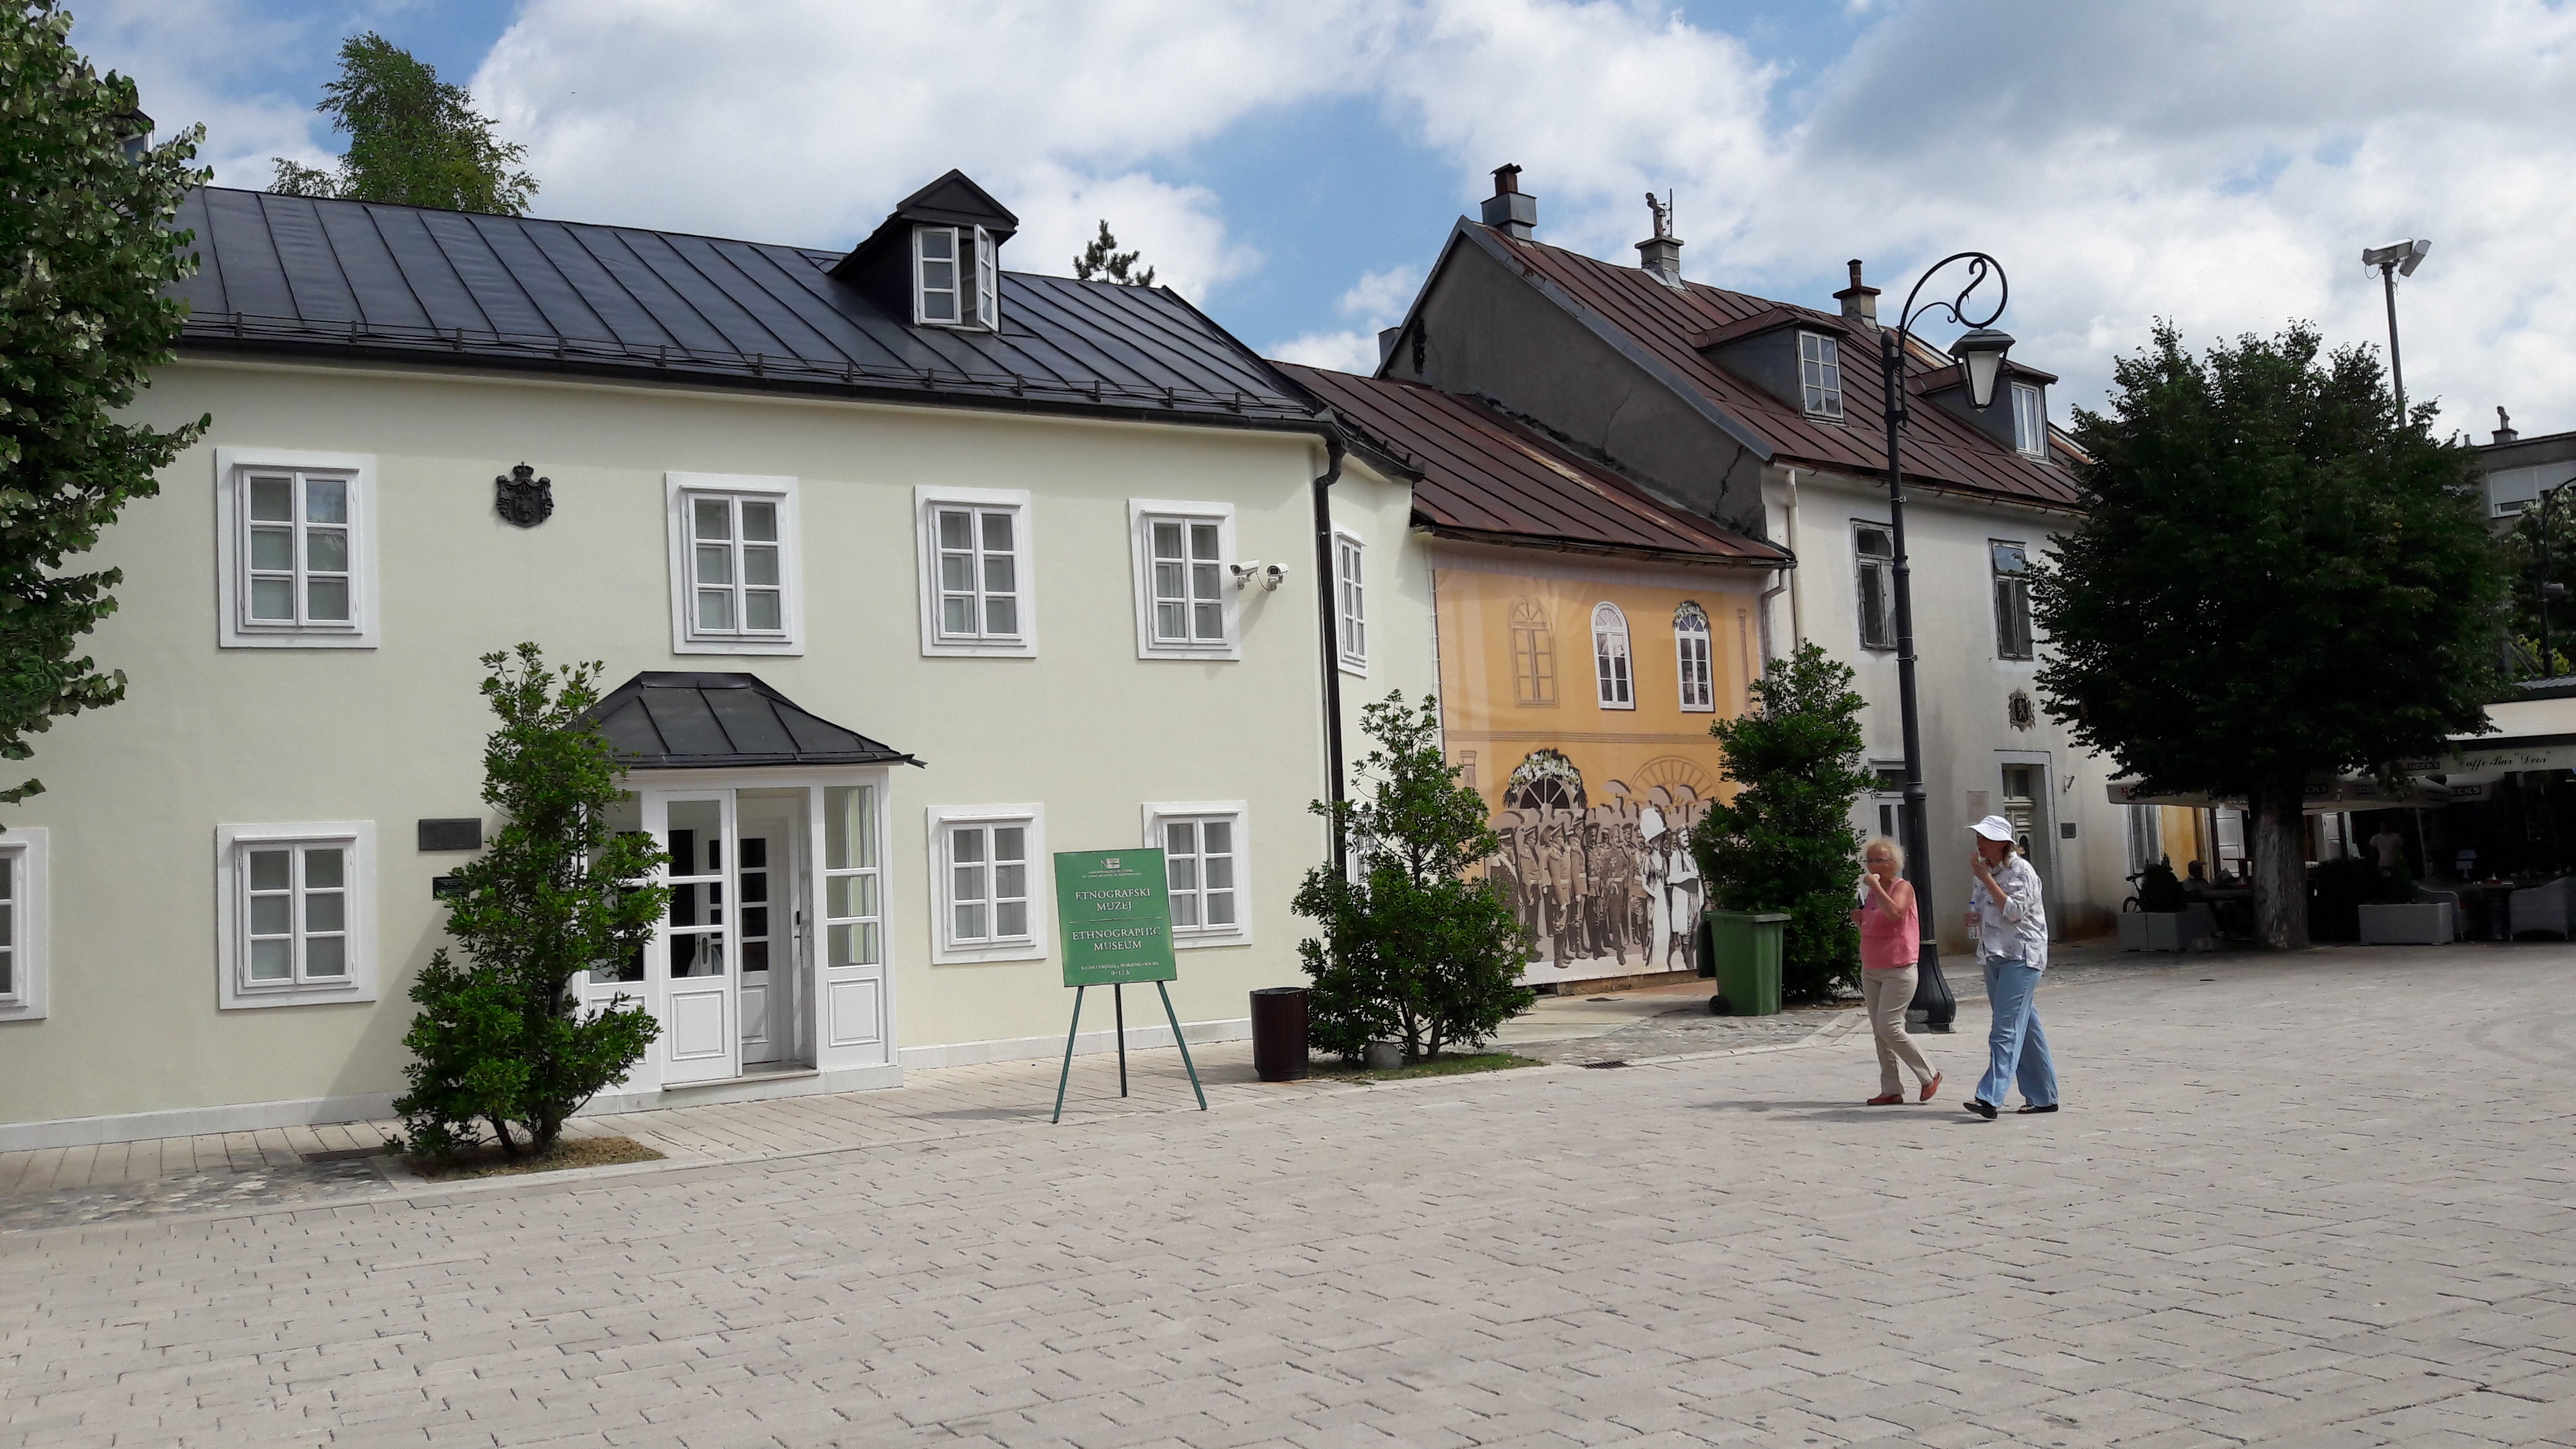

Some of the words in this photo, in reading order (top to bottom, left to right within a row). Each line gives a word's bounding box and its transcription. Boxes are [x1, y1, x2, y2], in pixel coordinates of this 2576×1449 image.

[1075, 888, 1151, 900] ETNOGRAFSKI
[1096, 901, 1132, 911] MUZEJ
[1072, 927, 1161, 940] ETHNOGRAPHIC
[1093, 940, 1143, 951] MUSEUM
